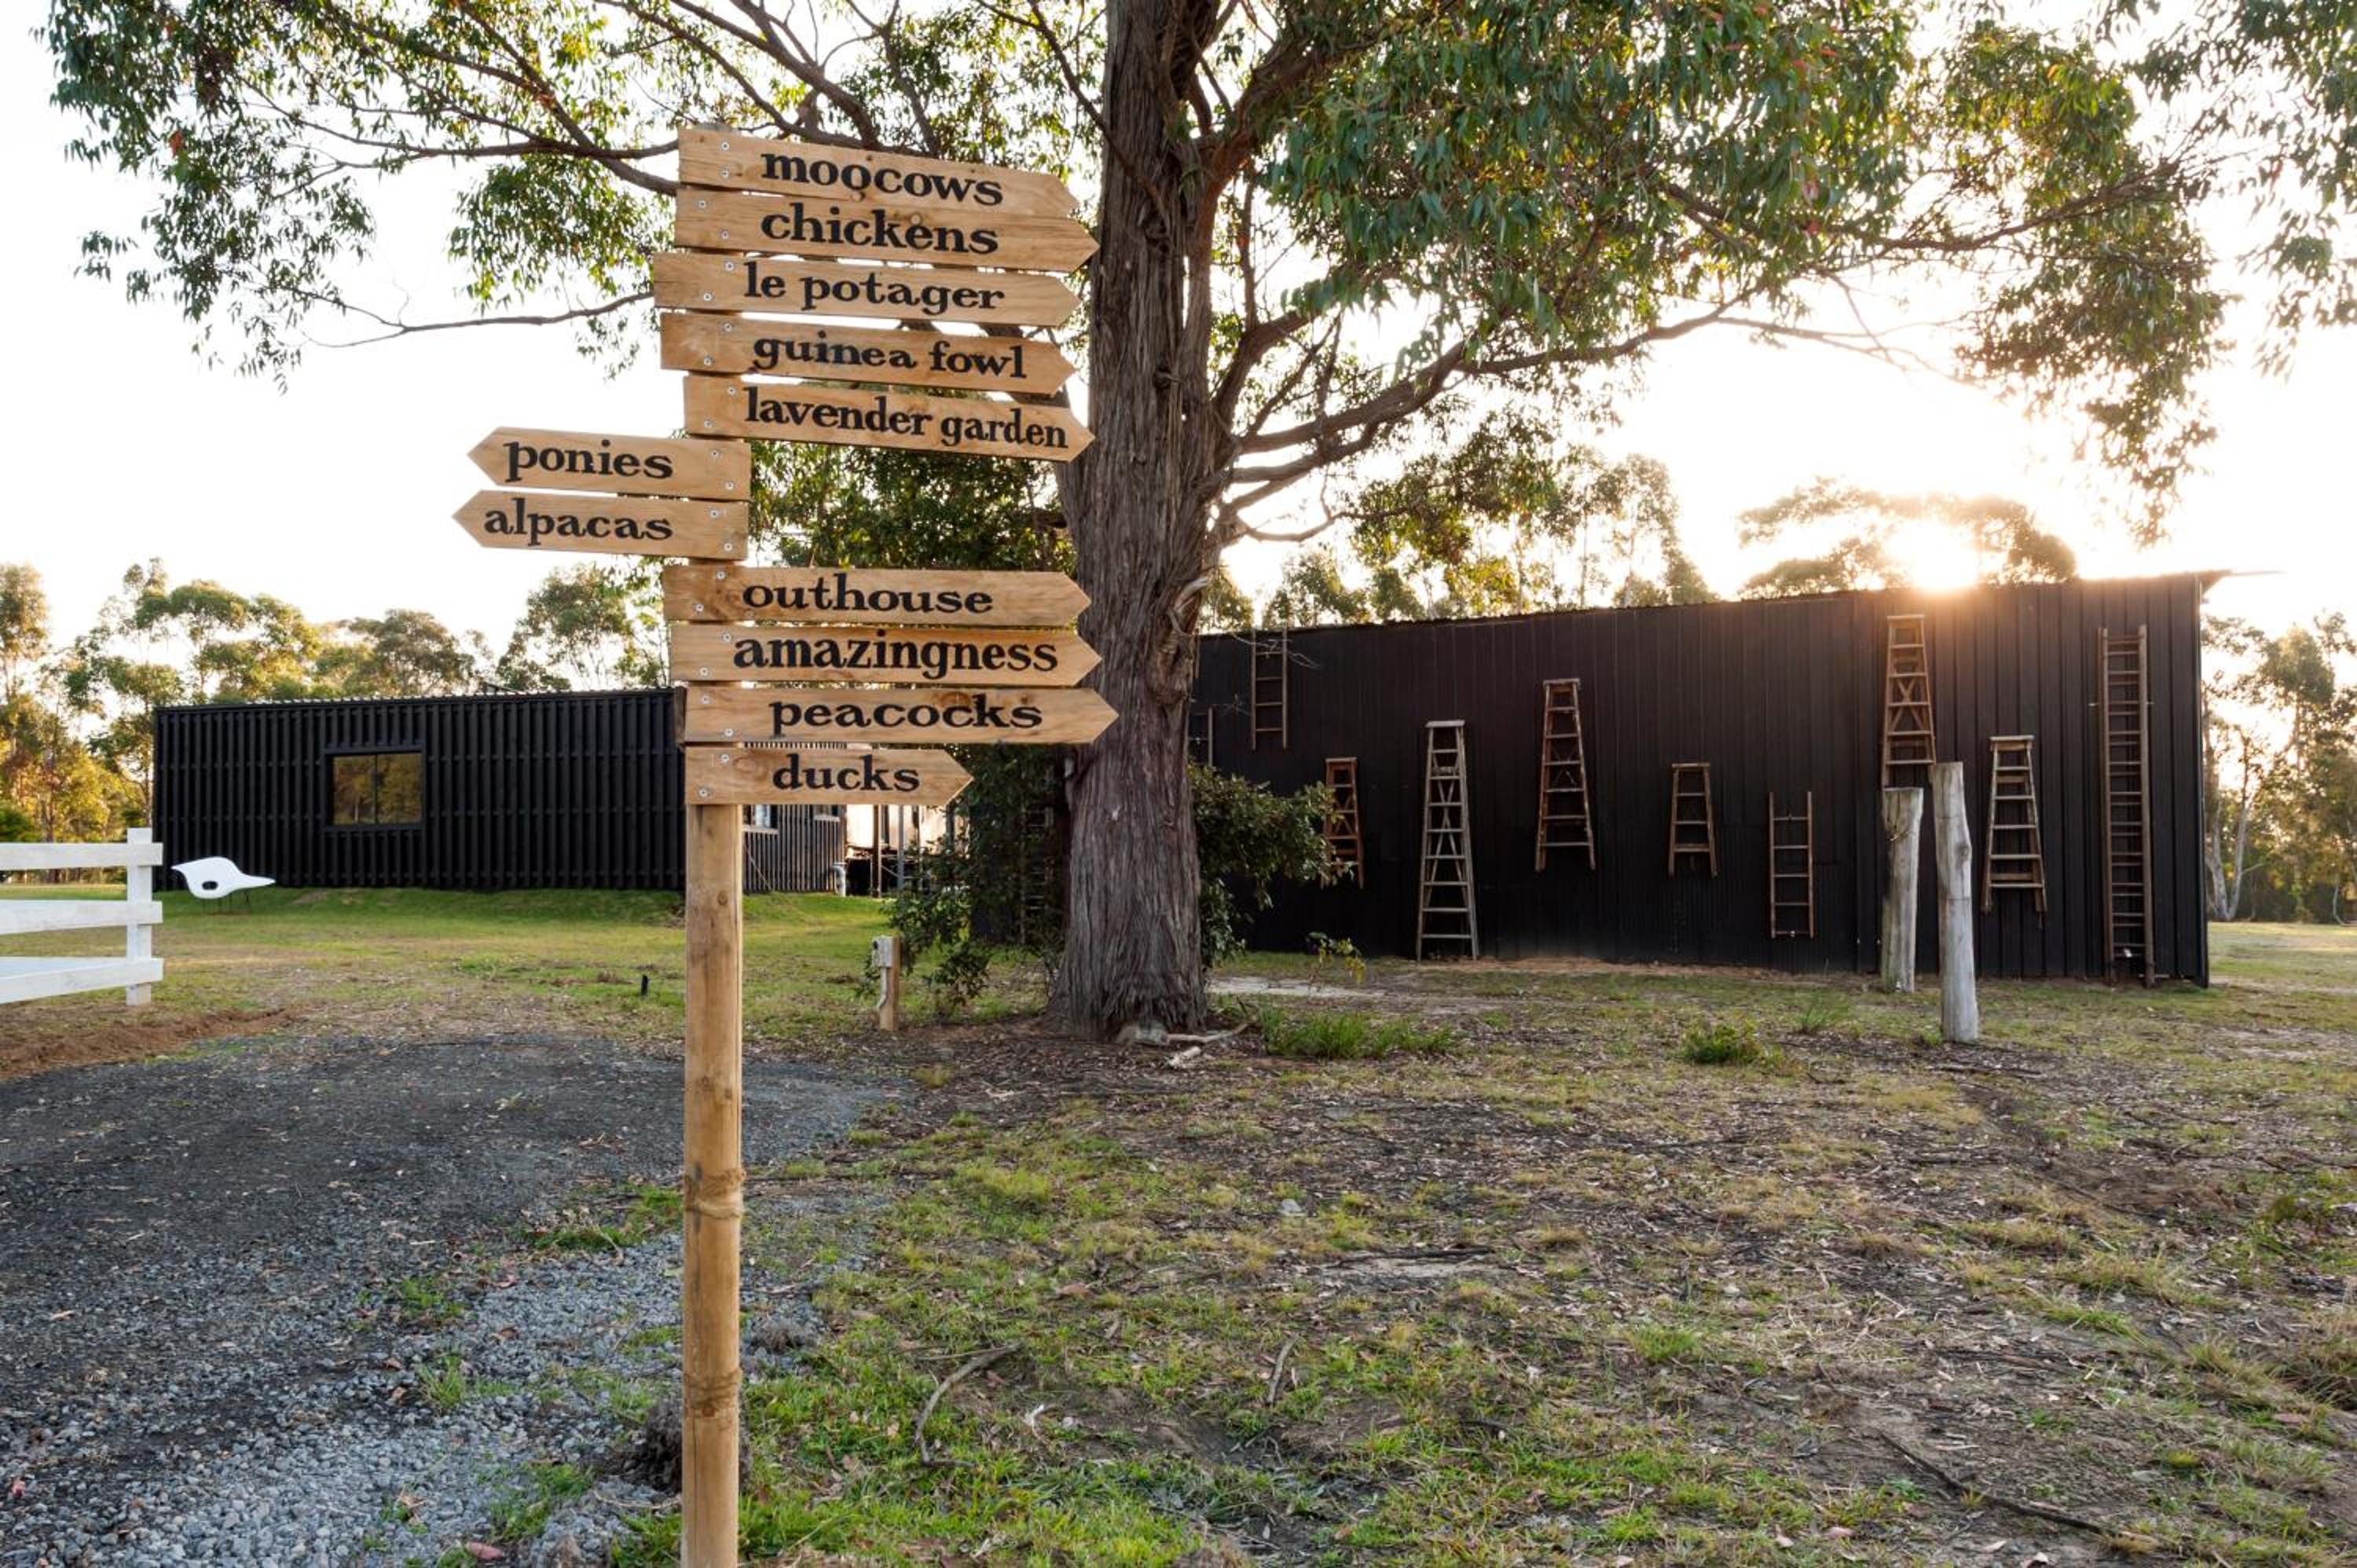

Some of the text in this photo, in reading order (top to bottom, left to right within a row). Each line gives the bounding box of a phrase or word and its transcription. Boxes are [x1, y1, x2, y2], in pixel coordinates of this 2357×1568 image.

[761, 152, 1003, 206] moocows
[761, 202, 999, 255] chickens
[743, 260, 1005, 316] le potager
[752, 330, 1027, 379] guinea fowl
[743, 386, 1069, 449] lavender garden
[504, 438, 673, 482] ponies
[484, 497, 673, 547] alpacas
[742, 572, 993, 614] outhouse
[733, 628, 1058, 680] amazingness
[768, 693, 1043, 739] peacocks
[772, 753, 920, 793] ducks
